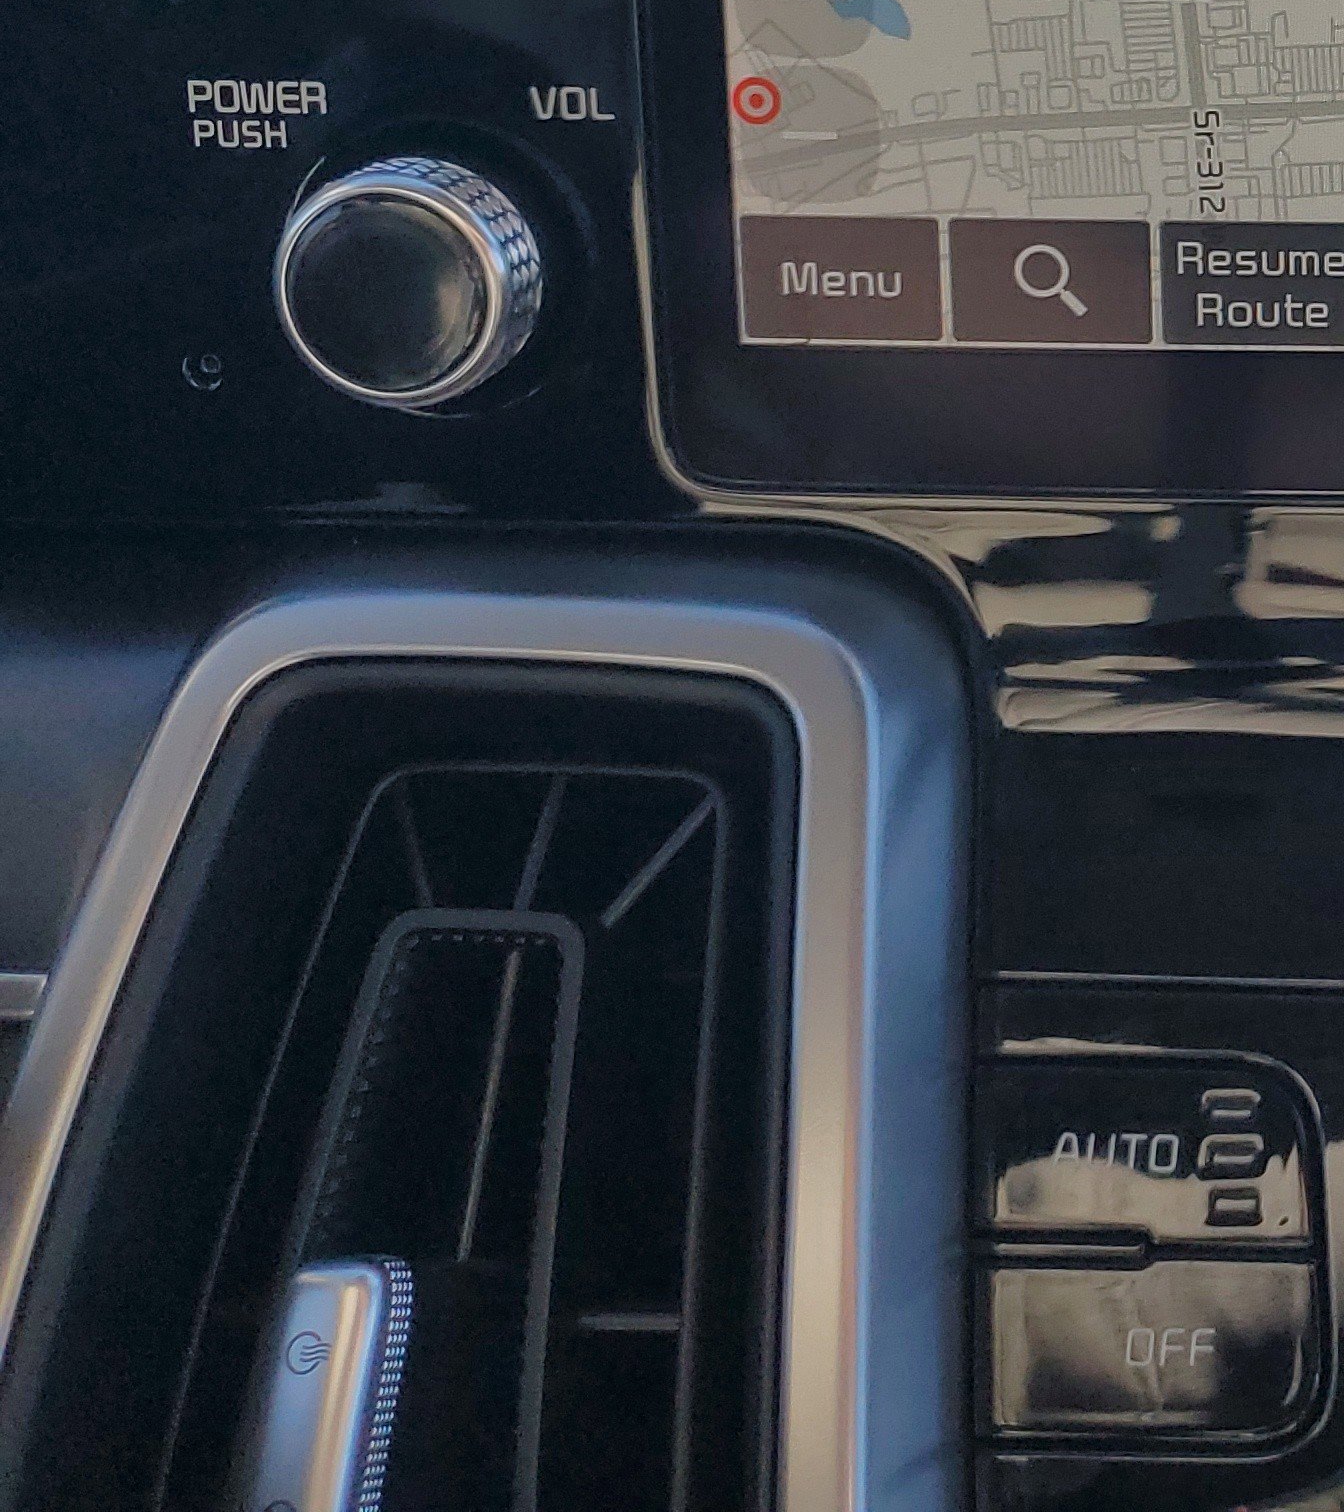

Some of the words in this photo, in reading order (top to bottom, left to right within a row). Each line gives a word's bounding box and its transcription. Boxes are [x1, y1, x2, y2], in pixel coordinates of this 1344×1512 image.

[187, 79, 327, 115] POWER
[530, 86, 615, 122] VOL
[193, 119, 288, 149] PUSH
[781, 261, 903, 299] Menu
[1197, 293, 1329, 328] Route
[1051, 1131, 1180, 1175] AUTO
[1125, 1327, 1217, 1367] OFF
